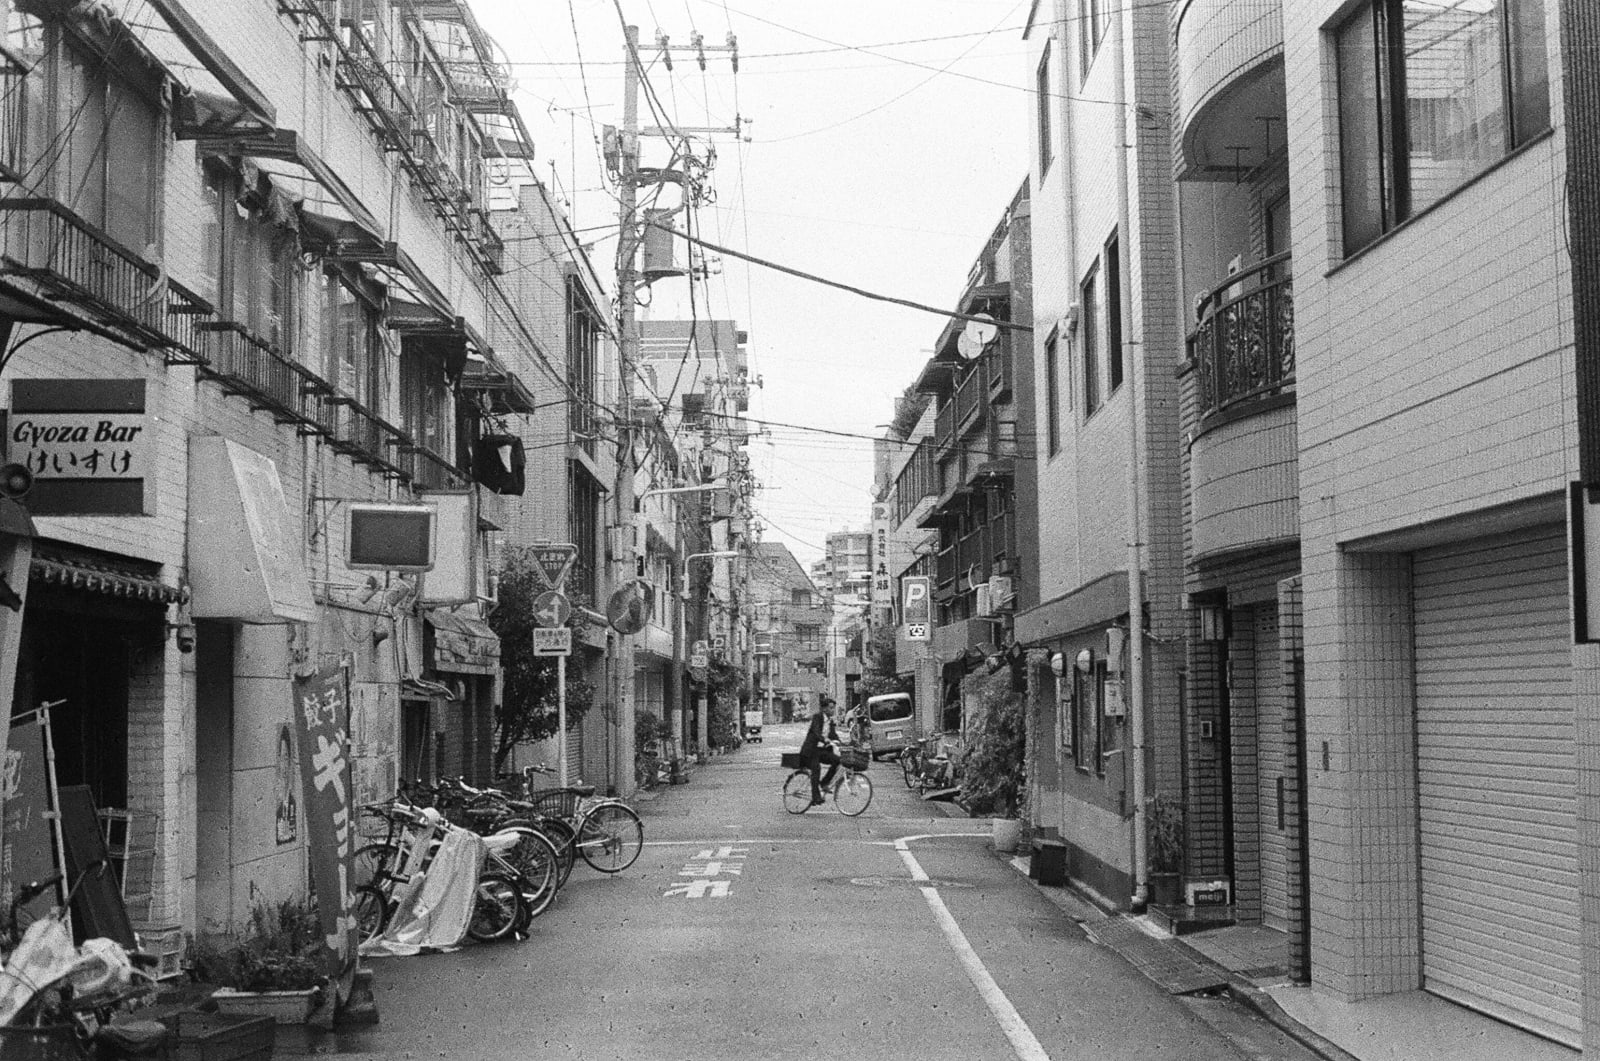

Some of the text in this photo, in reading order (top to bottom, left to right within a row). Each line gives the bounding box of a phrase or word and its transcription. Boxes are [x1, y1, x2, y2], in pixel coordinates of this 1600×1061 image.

[13, 420, 142, 448] Gyoza Bar
[27, 449, 131, 475] けいすけ
[544, 562, 563, 570] STOP
[906, 583, 926, 608] P
[303, 688, 341, 731] 餃子
[663, 846, 750, 898] 止まれ
[1198, 892, 1223, 902] meiji
